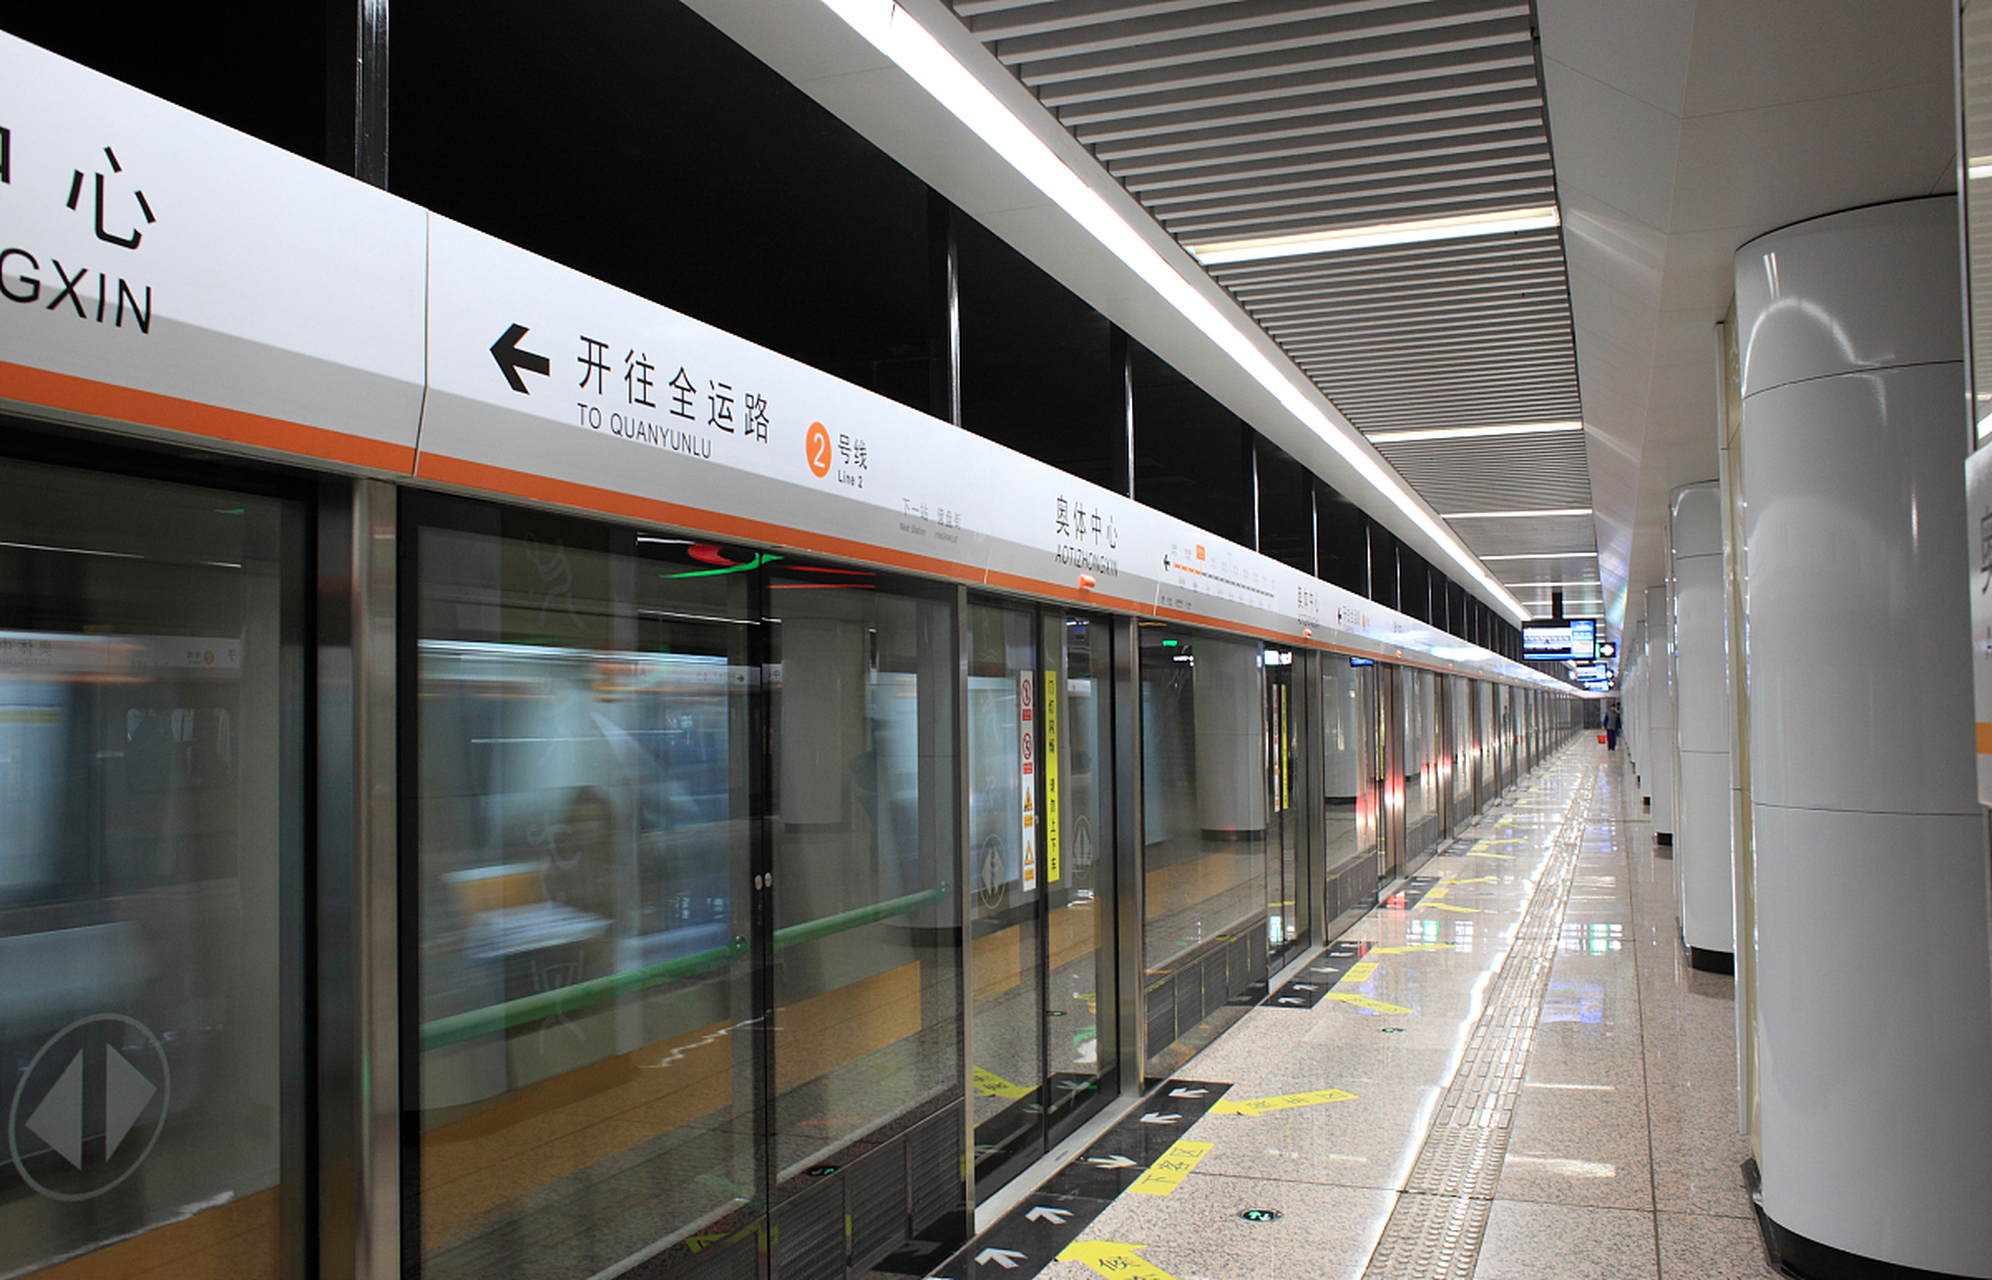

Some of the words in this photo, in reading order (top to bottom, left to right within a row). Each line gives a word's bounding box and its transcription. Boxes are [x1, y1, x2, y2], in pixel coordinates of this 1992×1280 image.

[0, 126, 157, 250] 心
[0, 247, 153, 335] GXIN
[577, 335, 770, 445] 开往全运路
[577, 402, 602, 430] TO
[610, 412, 712, 459] QUANYUNLU
[813, 432, 826, 469] 2
[838, 433, 868, 471] 号线
[838, 469, 855, 486] Line
[858, 475, 864, 489] 2
[1055, 494, 1118, 549] 奥体中心
[1055, 543, 1118, 577] AOTIZHONGXIN
[1141, 1147, 1204, 1185] 下客区
